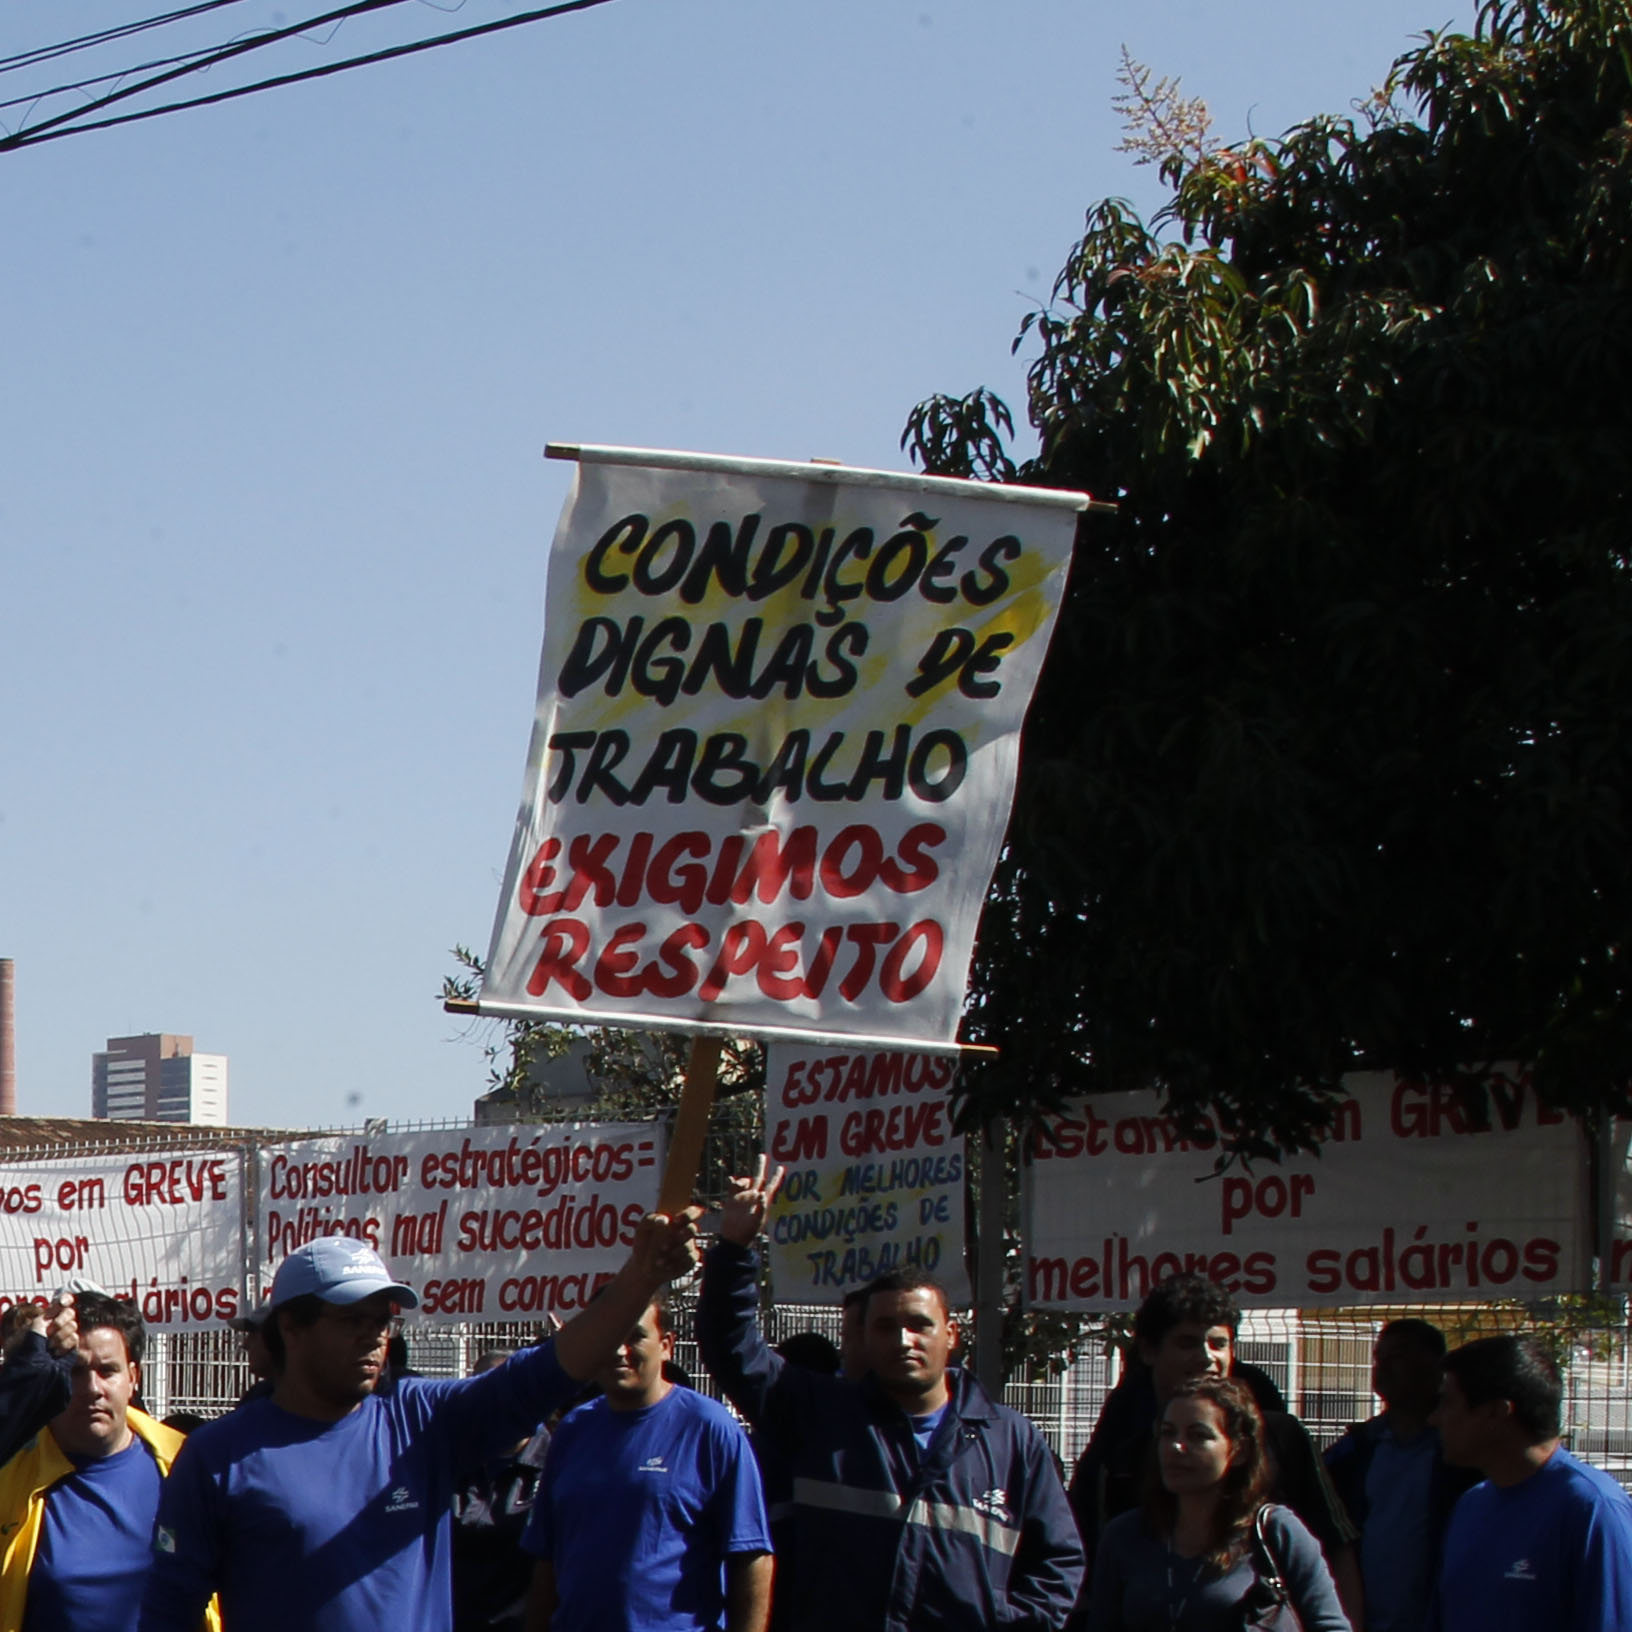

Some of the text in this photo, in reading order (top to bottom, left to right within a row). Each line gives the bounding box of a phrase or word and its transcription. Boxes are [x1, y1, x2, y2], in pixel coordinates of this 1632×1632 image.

[583, 511, 1023, 628] CONDIÇÕES
[556, 614, 1016, 708] DIGNAS DE
[546, 723, 969, 806] TRABALHO
[518, 823, 948, 918] EXIGIMOS
[525, 917, 945, 1005] RESPEITO
[771, 1114, 828, 1162] EM
[58, 1176, 105, 1213] em
[124, 1159, 228, 1207] GREVE
[269, 1144, 408, 1200] Consultor
[839, 1153, 963, 1196] MELHORES
[1222, 1172, 1316, 1235] por
[391, 1200, 447, 1257] mal
[458, 1193, 644, 1254] sucedidos
[773, 1195, 951, 1246] CONDIÇÕES DE
[33, 1235, 89, 1283] por
[1031, 1232, 1278, 1302] melhores
[1306, 1221, 1561, 1293] salários
[422, 1276, 493, 1315] sem
